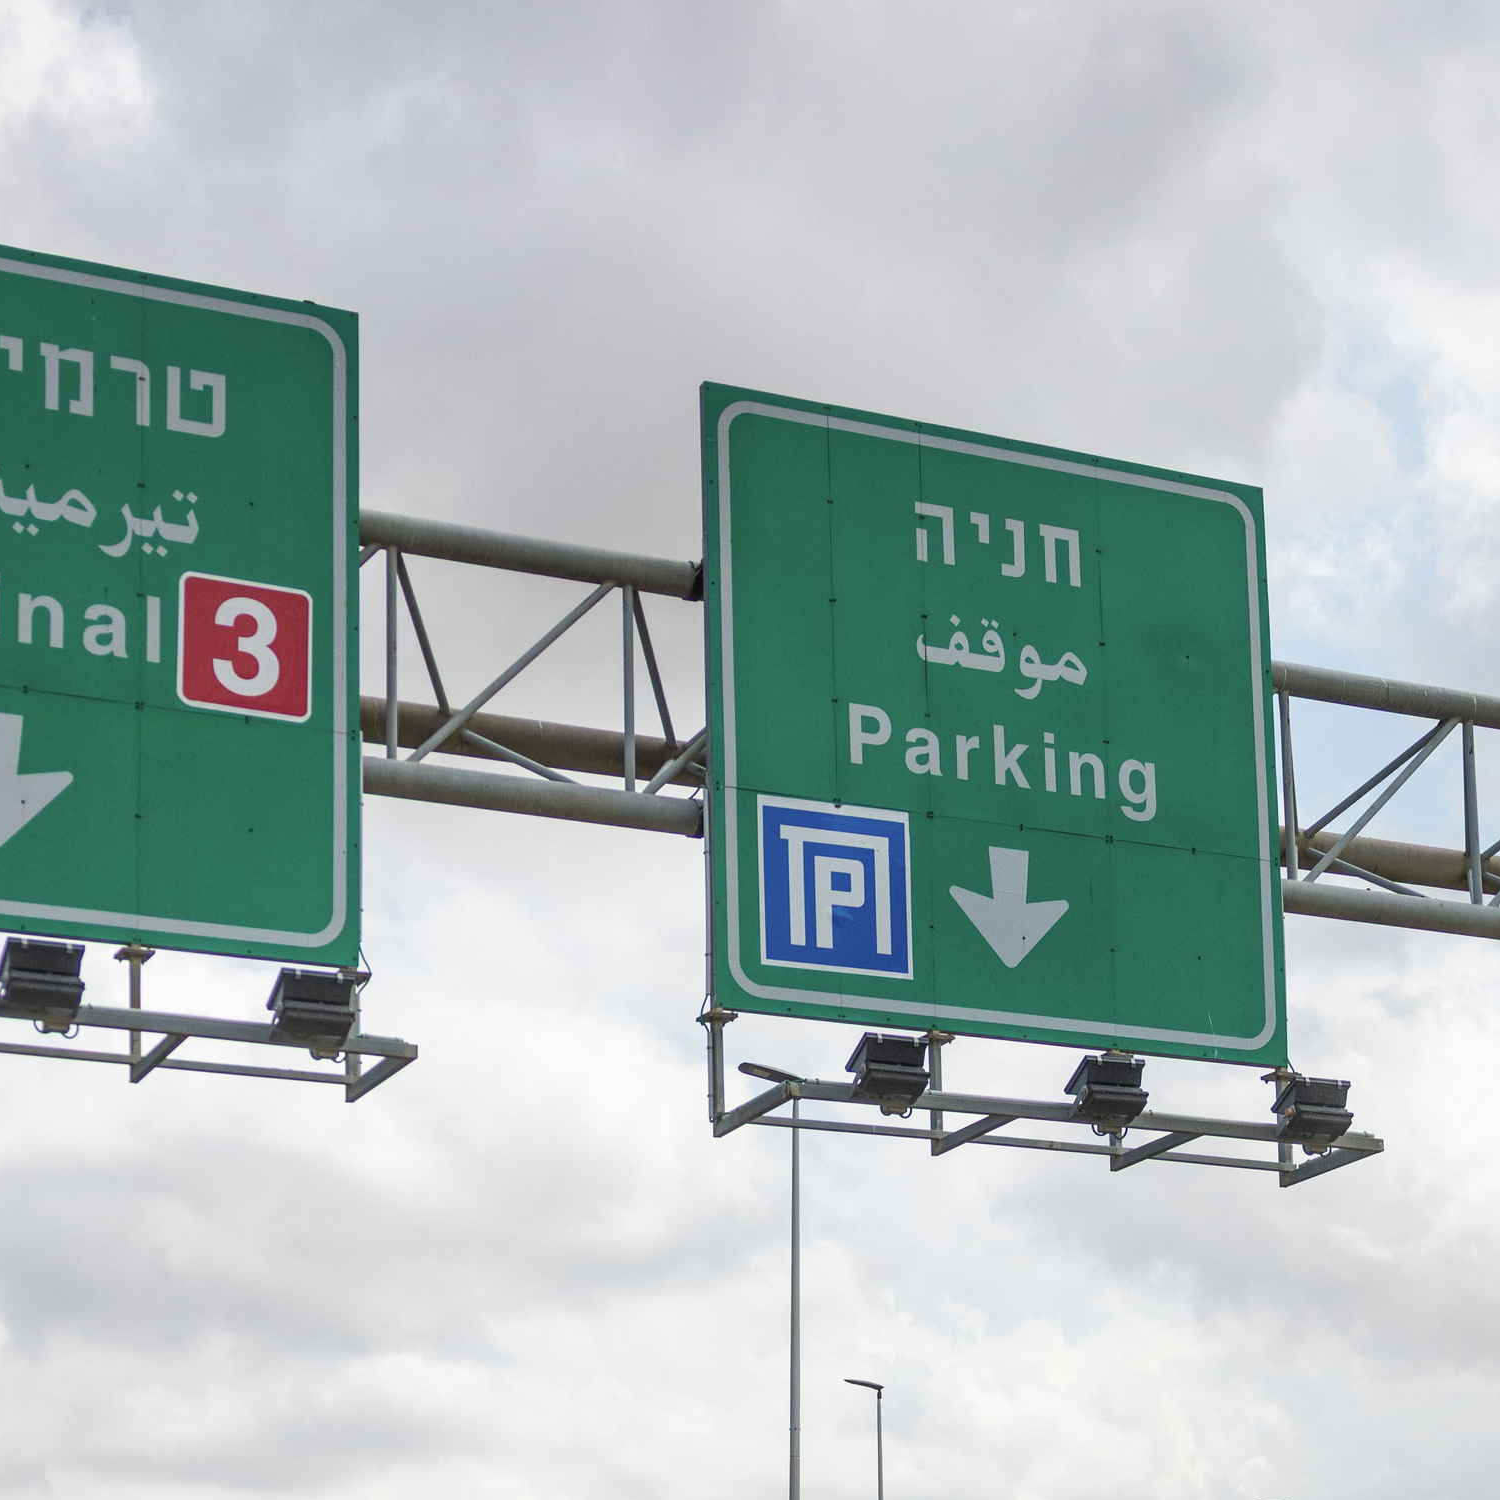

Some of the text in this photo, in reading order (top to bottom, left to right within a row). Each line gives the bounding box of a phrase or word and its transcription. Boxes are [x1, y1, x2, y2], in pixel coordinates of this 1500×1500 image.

[914, 501, 1082, 588] חניה
[211, 596, 281, 698] 3
[915, 613, 1088, 700] موقف
[848, 702, 1158, 822] Parking
